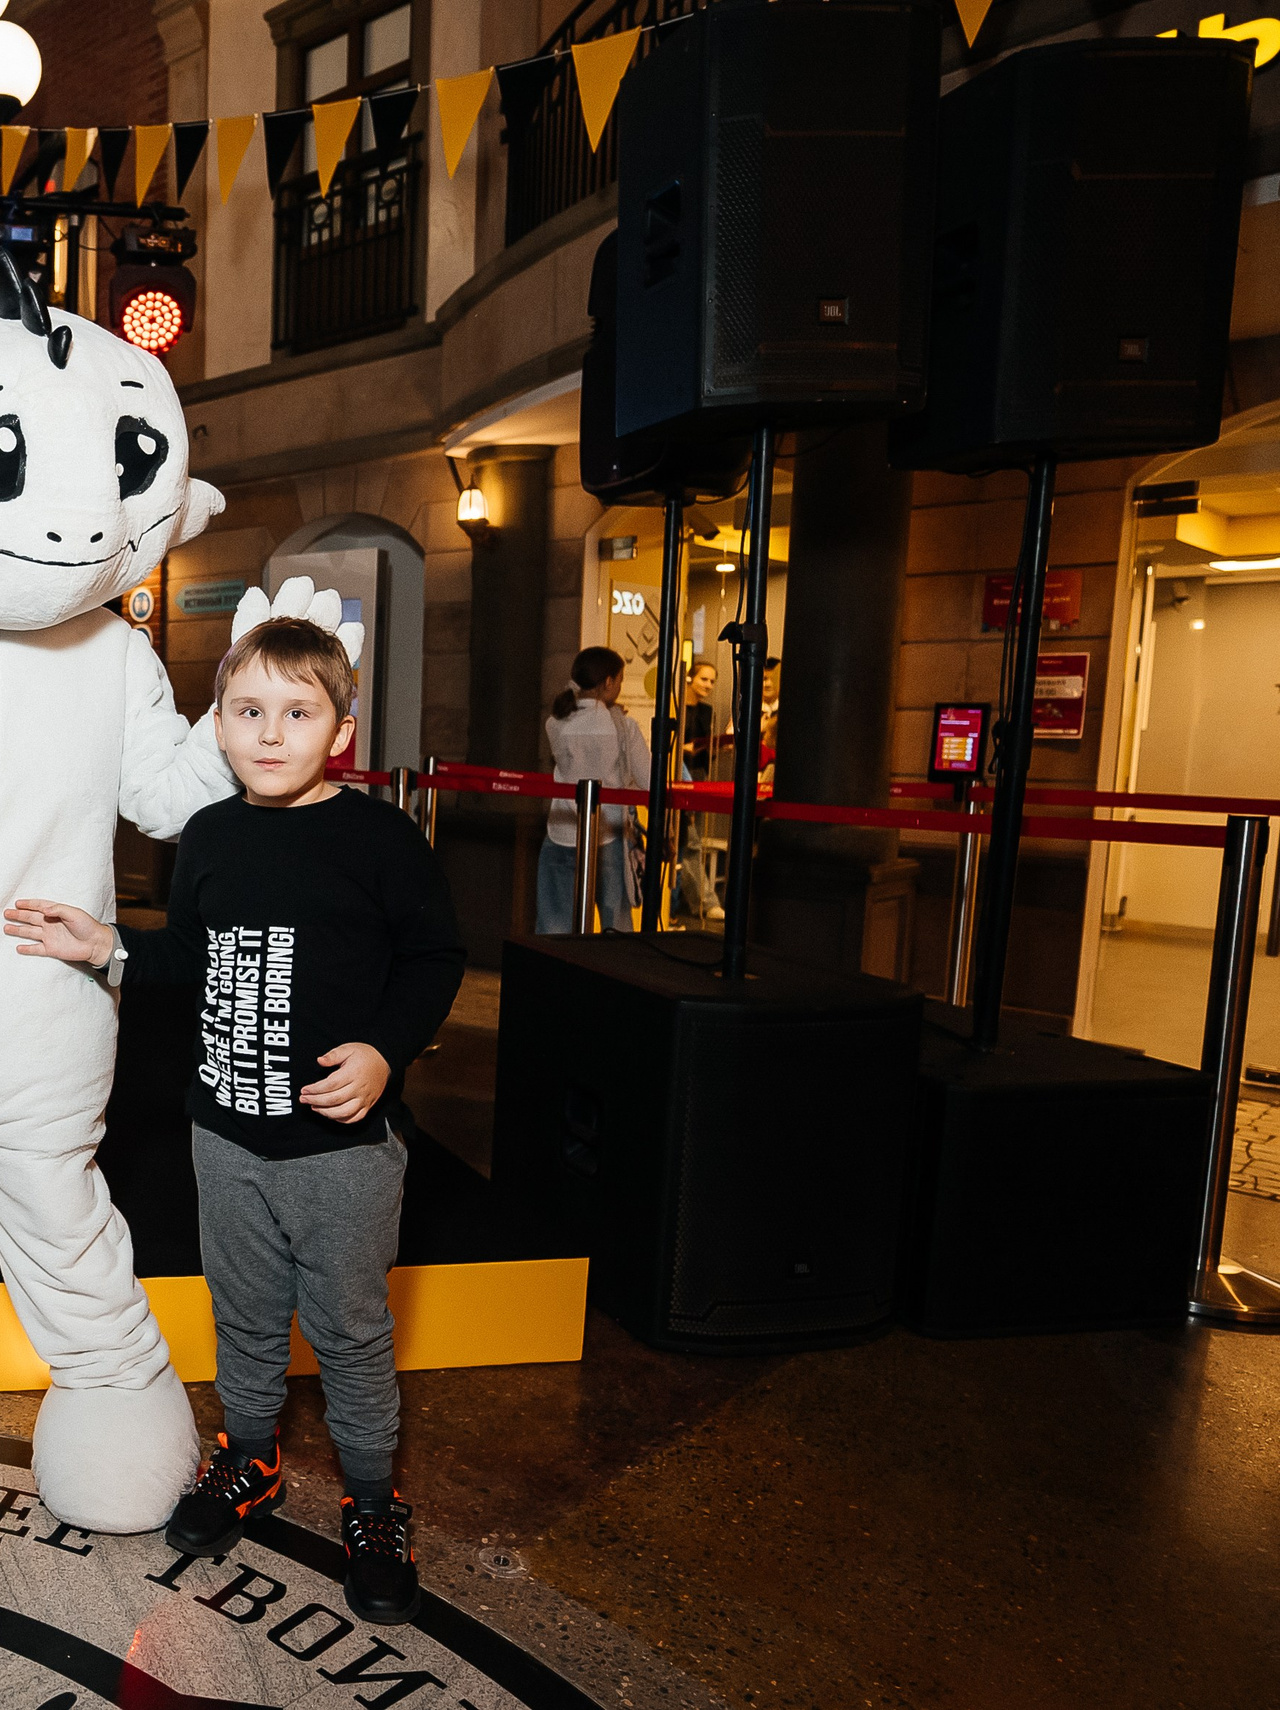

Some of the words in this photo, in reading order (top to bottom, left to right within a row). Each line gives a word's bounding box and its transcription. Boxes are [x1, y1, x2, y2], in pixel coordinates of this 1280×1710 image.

[238, 926, 263, 948] IT
[263, 926, 295, 1014] BORING!
[214, 999, 232, 1032] I'M
[232, 953, 261, 1056] PROMISE
[263, 1018, 290, 1047] BE
[216, 1034, 233, 1108] WHERE
[232, 1059, 258, 1069] I
[263, 1050, 293, 1116] WON'T
[233, 1072, 260, 1116] BUT
